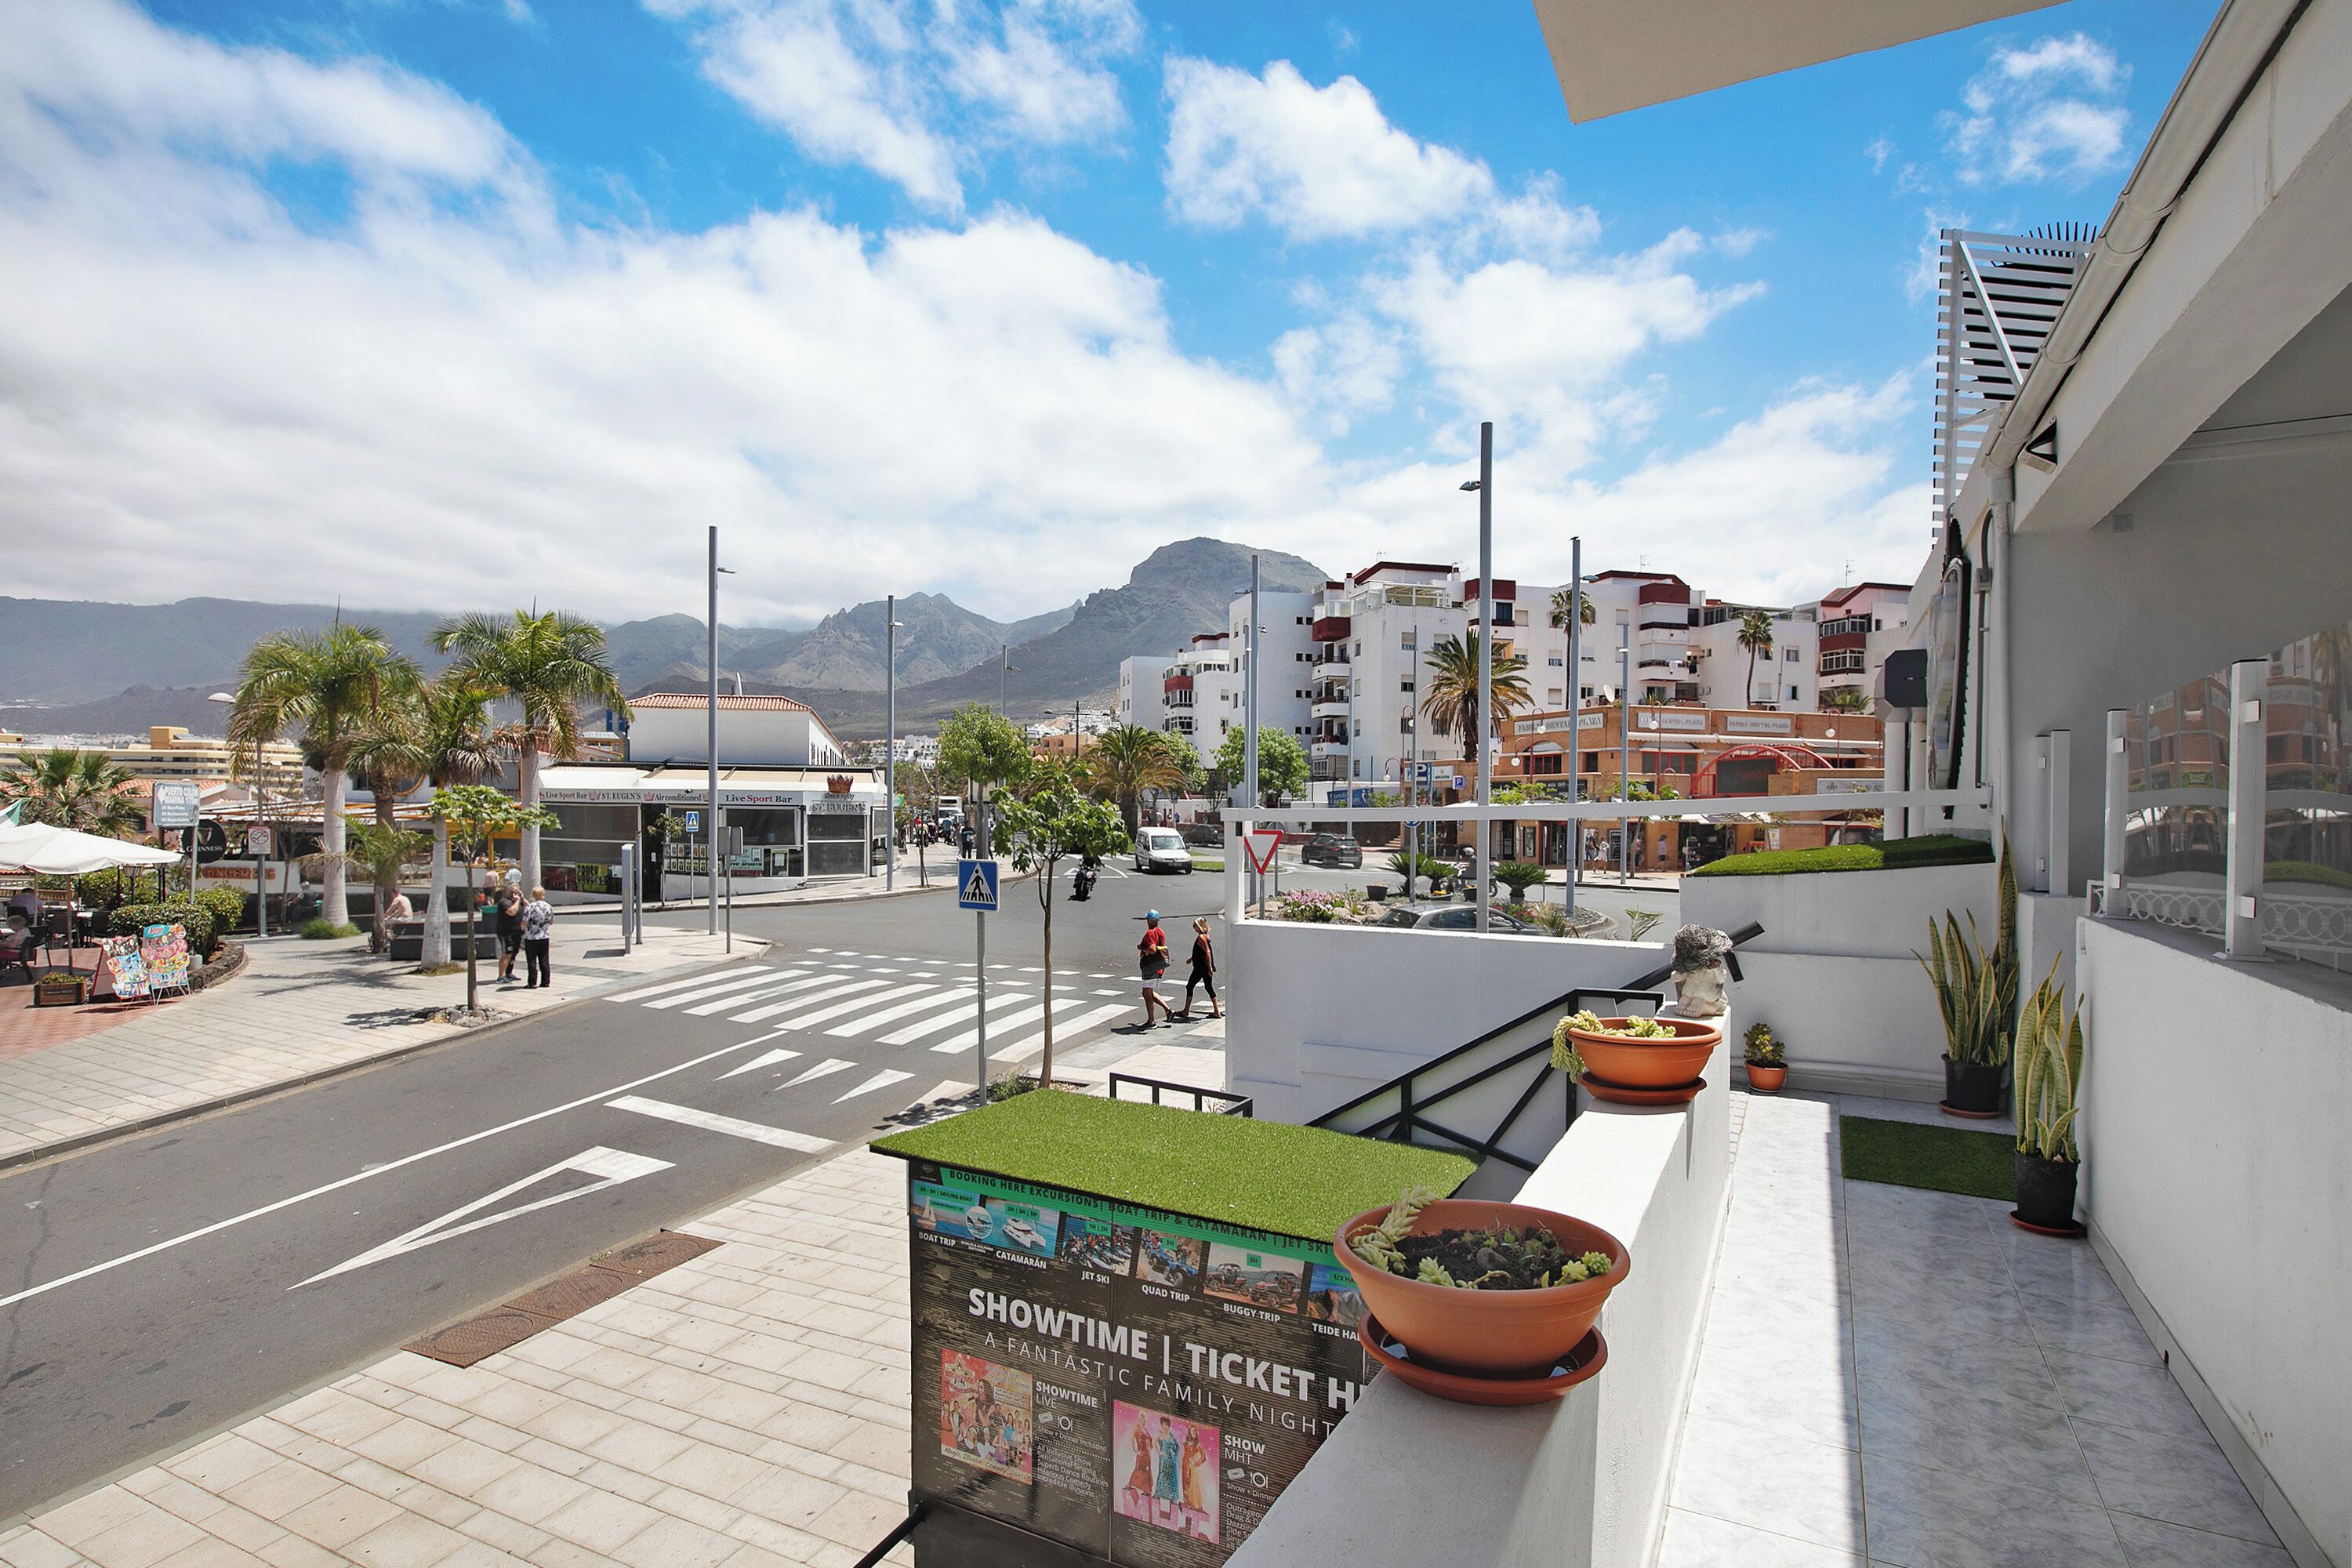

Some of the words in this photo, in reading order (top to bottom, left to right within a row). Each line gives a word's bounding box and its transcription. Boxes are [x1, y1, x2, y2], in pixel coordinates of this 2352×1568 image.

[1579, 717, 1602, 727] PLAZA
[165, 786, 183, 797] PUERTO
[165, 796, 185, 804] MARINA
[559, 792, 575, 800] Sport
[746, 795, 773, 804] Sport
[201, 867, 252, 880] GINGER
[940, 1191, 959, 1200] SAILING
[949, 1170, 996, 1187] BOOKING
[1000, 1180, 1026, 1193] HERE
[1144, 1210, 1171, 1222] TRIP
[919, 1232, 938, 1243] BOAT
[939, 1236, 956, 1247] TRIP
[996, 1250, 1047, 1269] CATAMARÁN
[1081, 1270, 1095, 1282] JET
[1096, 1273, 1109, 1285] SKI
[1142, 1284, 1168, 1298] QUAD
[1170, 1290, 1190, 1303] TRIP
[1223, 1303, 1257, 1318] BUGGY
[1259, 1311, 1281, 1323] TRIP
[1312, 1323, 1340, 1338] TEIDE
[968, 1287, 1148, 1361] SHOWTIME
[1185, 1342, 1316, 1402] TICKET
[985, 1331, 996, 1348] A
[1008, 1338, 1130, 1386] FANTASTIC
[1145, 1375, 1235, 1414] FAMILY
[1036, 1381, 1098, 1408] SHOWTIME
[1036, 1393, 1058, 1409] LIVE
[1038, 1426, 1054, 1436] Show
[1059, 1432, 1079, 1443] Dinner
[1225, 1434, 1265, 1455] SHOW
[1037, 1451, 1073, 1468] Sensational
[1074, 1462, 1097, 1477] Singing
[1047, 1445, 1073, 1460] Inclusive
[1074, 1455, 1092, 1466] Show
[1225, 1447, 1253, 1465] MHT
[1037, 1459, 1059, 1472] Superb
[1061, 1466, 1080, 1479] Dance
[1081, 1473, 1109, 1487] Routines
[1037, 1466, 1065, 1482] Hilarious
[1037, 1473, 1068, 1490] Incredible
[1227, 1483, 1246, 1494] Show
[1252, 1490, 1276, 1502] Dinner
[1226, 1510, 1244, 1523] Drag
